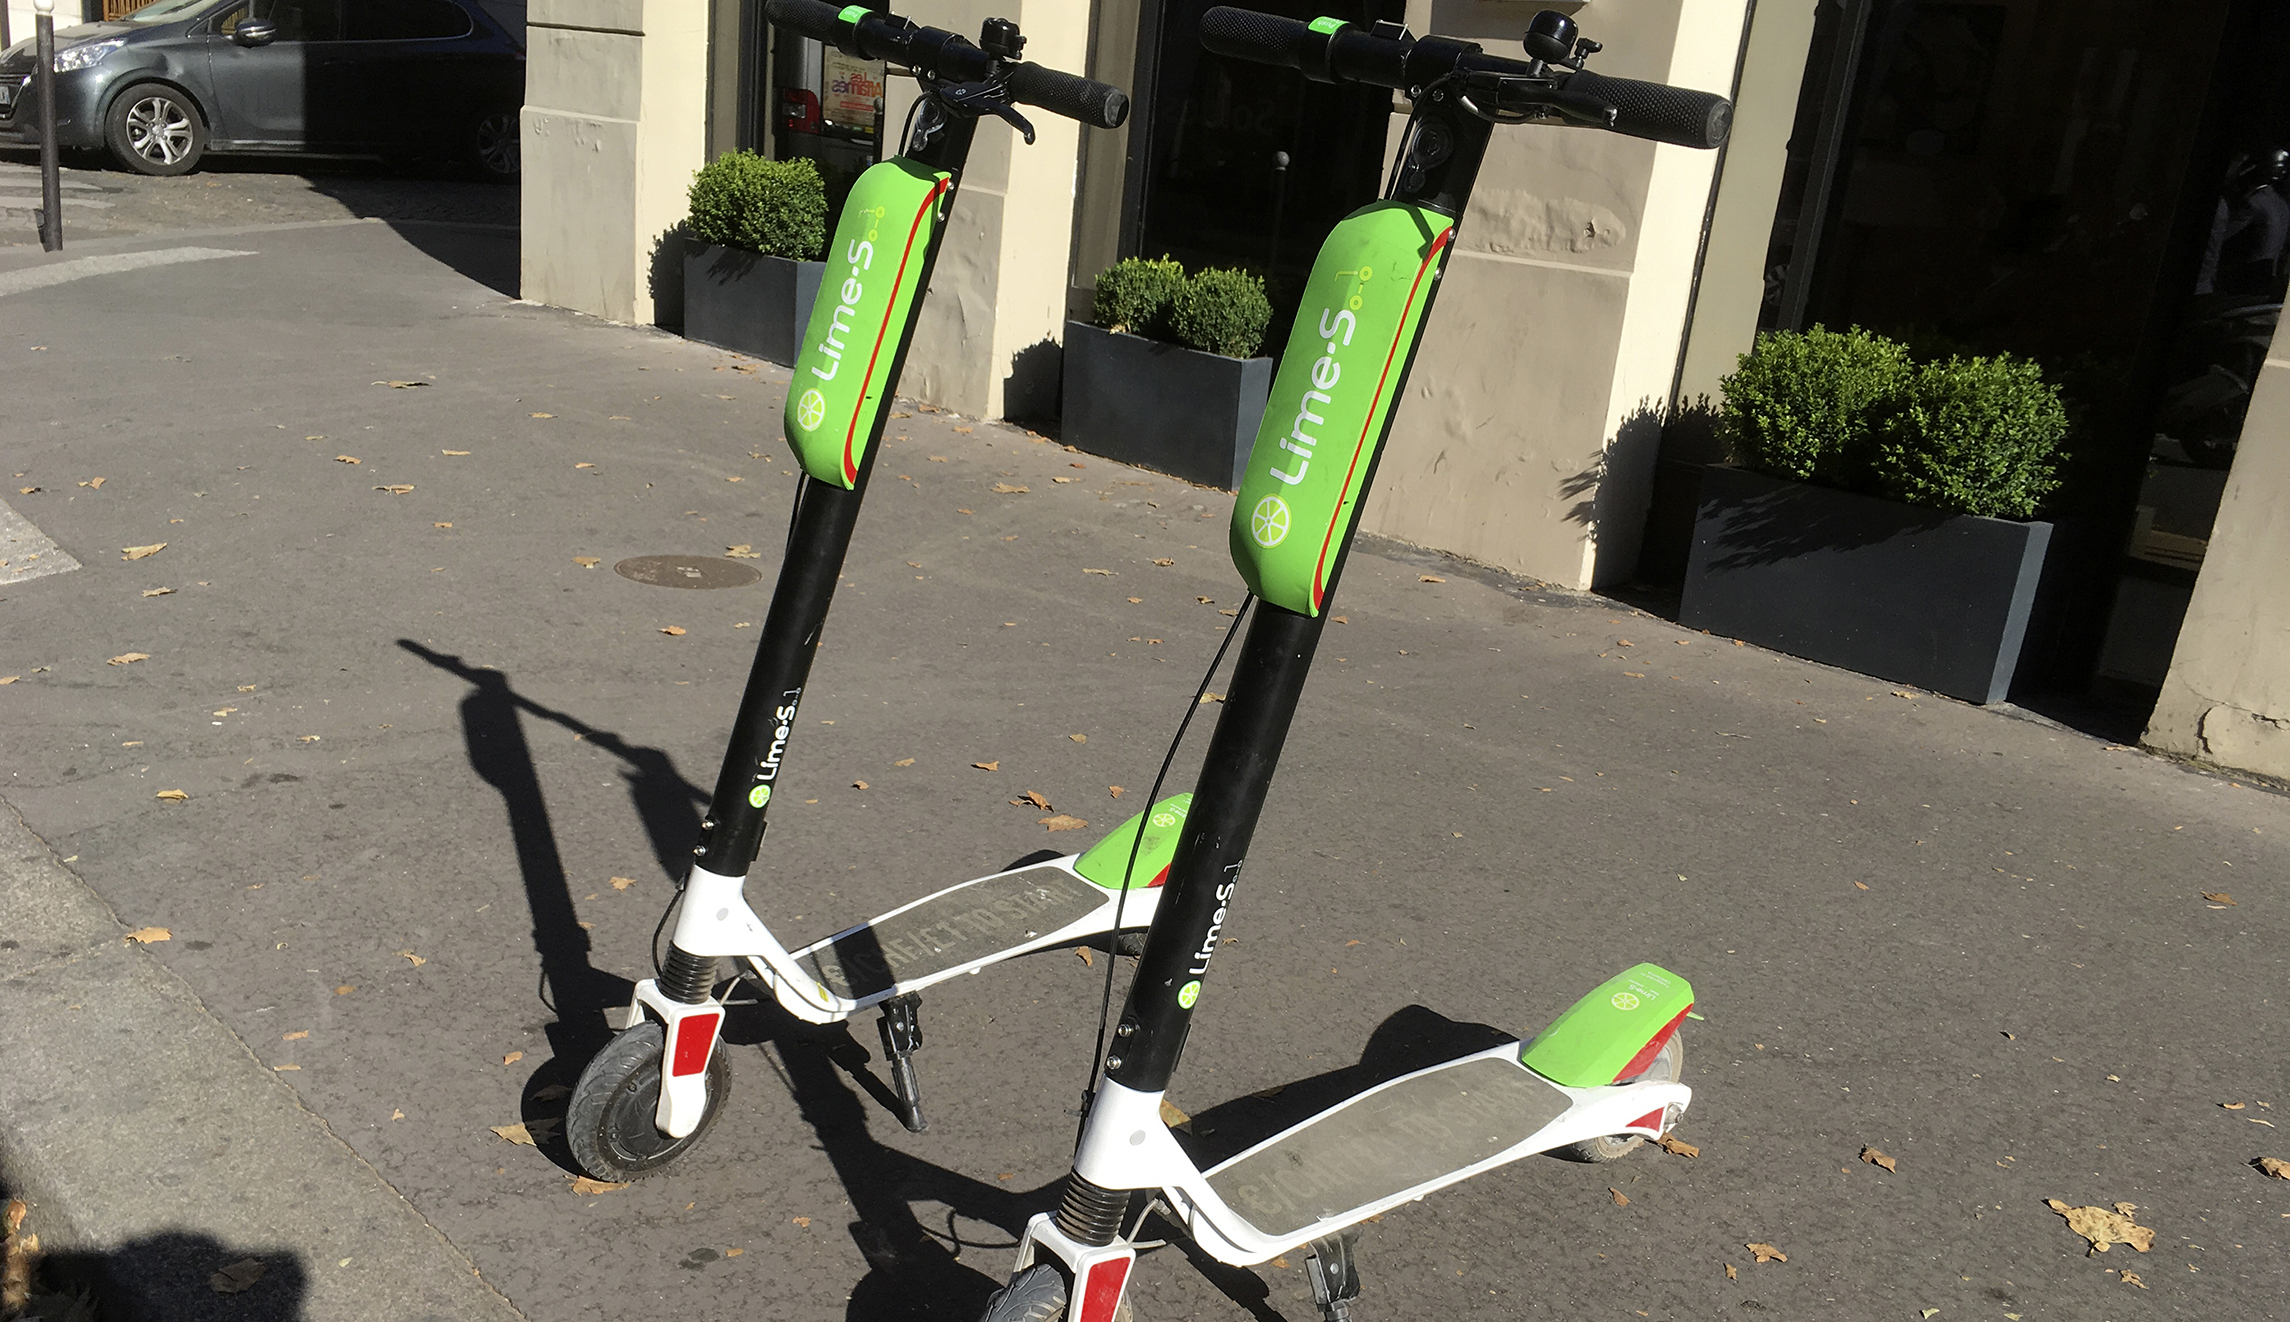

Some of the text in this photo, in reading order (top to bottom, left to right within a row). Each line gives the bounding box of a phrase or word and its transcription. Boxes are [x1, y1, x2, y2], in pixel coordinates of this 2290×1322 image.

[811, 238, 875, 381] Lime-S
[1269, 308, 1357, 486] Lime-S
[756, 705, 796, 780] Lime-S
[994, 878, 1080, 922] START
[1188, 882, 1236, 975] Lime-S
